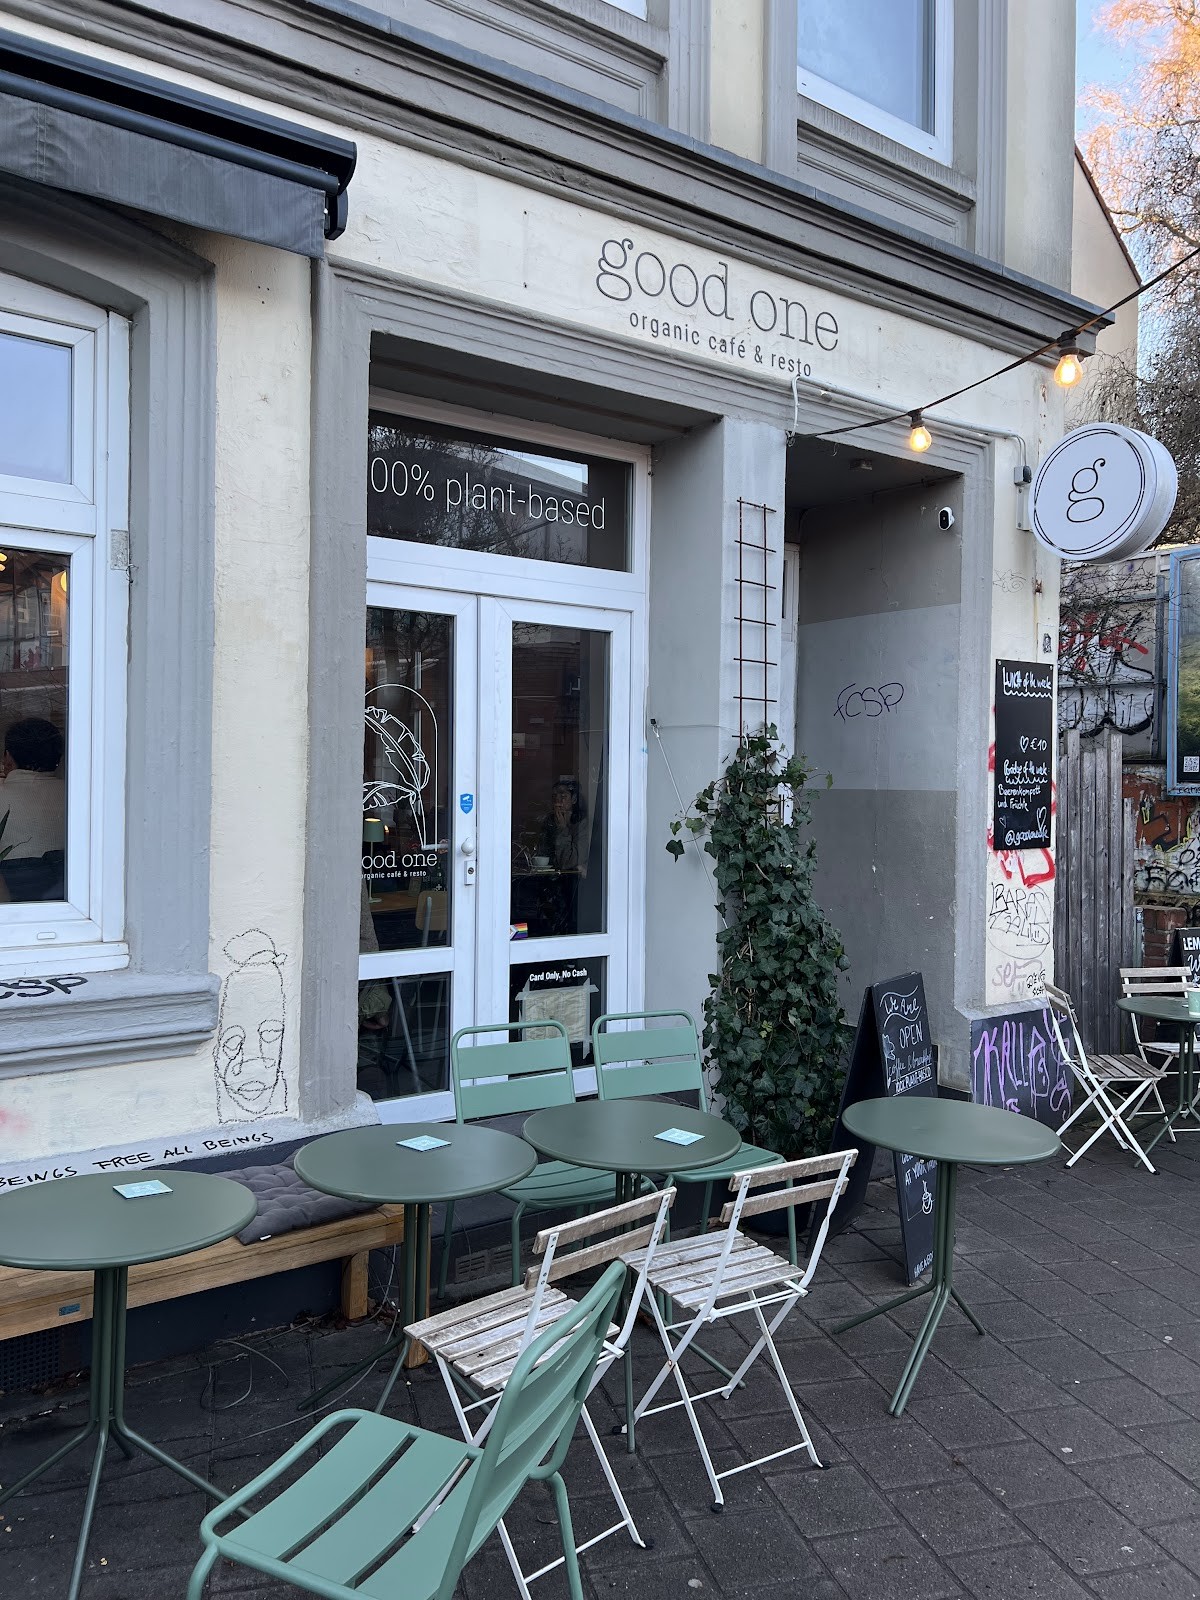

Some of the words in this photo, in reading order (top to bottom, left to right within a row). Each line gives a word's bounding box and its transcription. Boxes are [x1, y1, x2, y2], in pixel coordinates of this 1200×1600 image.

[596, 238, 735, 321] good
[750, 290, 839, 352] one
[629, 312, 700, 345] organic
[708, 335, 746, 358] café
[754, 345, 763, 364] &
[771, 352, 811, 377] resto
[370, 457, 435, 501] 00%
[446, 472, 605, 530] plant-based
[1066, 457, 1106, 523] g
[362, 851, 397, 869] ood
[402, 853, 437, 868] one
[529, 972, 545, 982] Card
[562, 969, 571, 979] No
[572, 968, 588, 978] Cash
[899, 1021, 923, 1049] OPEN
[92, 1152, 155, 1170] FREE
[163, 1145, 193, 1159] ALL
[202, 1132, 274, 1151] BEINGS
